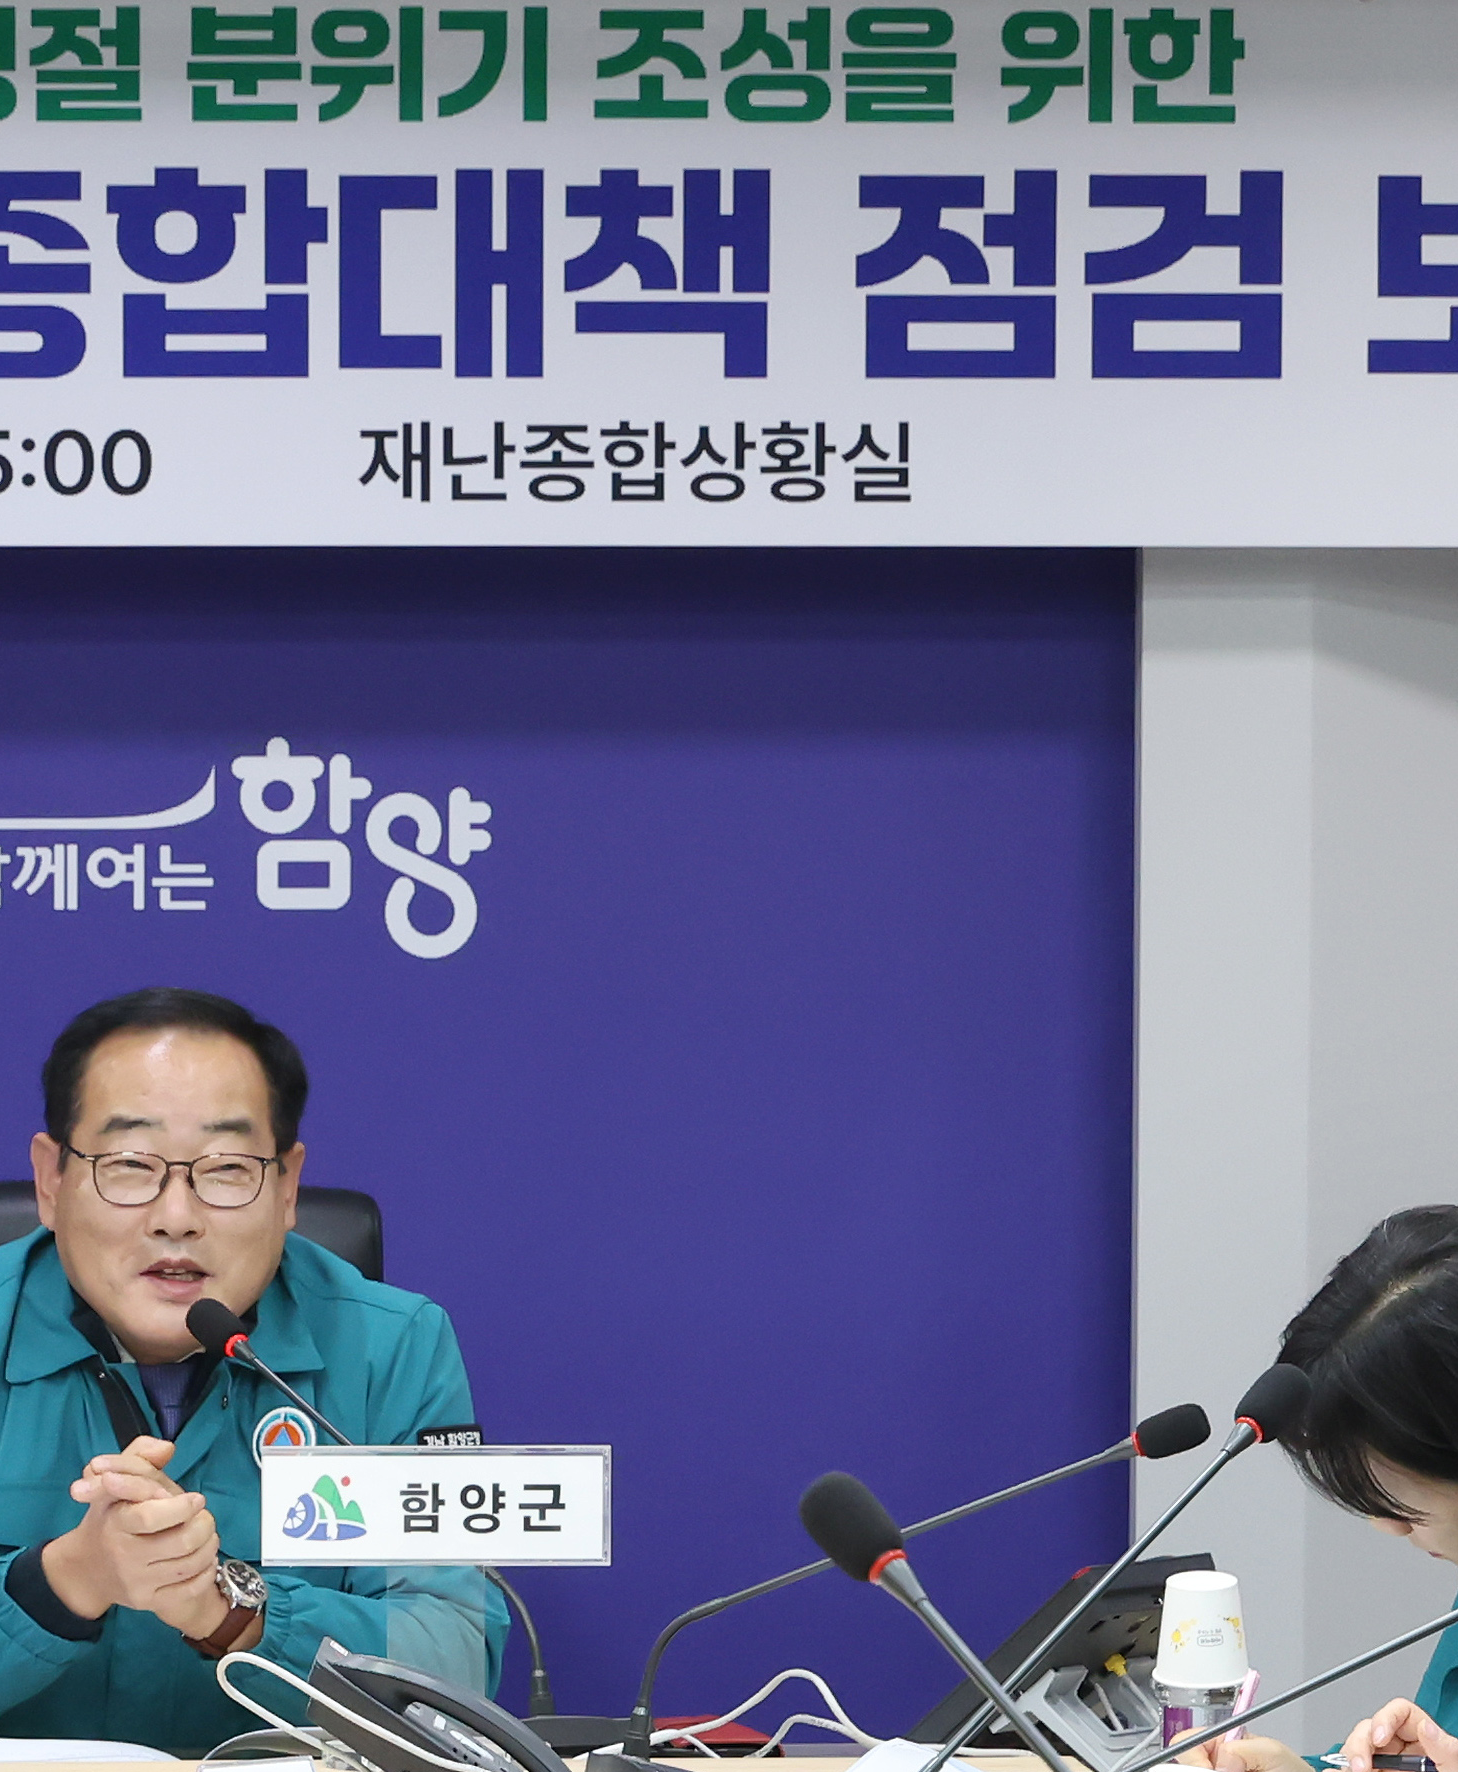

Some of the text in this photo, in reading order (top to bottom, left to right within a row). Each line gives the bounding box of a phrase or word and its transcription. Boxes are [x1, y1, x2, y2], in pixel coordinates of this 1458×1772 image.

[187, 5, 549, 123] 분위기
[593, 6, 958, 123] 조성을
[1000, 7, 1246, 124] 위한
[855, 169, 1284, 380] 점검
[359, 420, 911, 503] 재난종합상황실
[231, 736, 492, 960] 함양
[399, 1482, 566, 1534] 함양군
